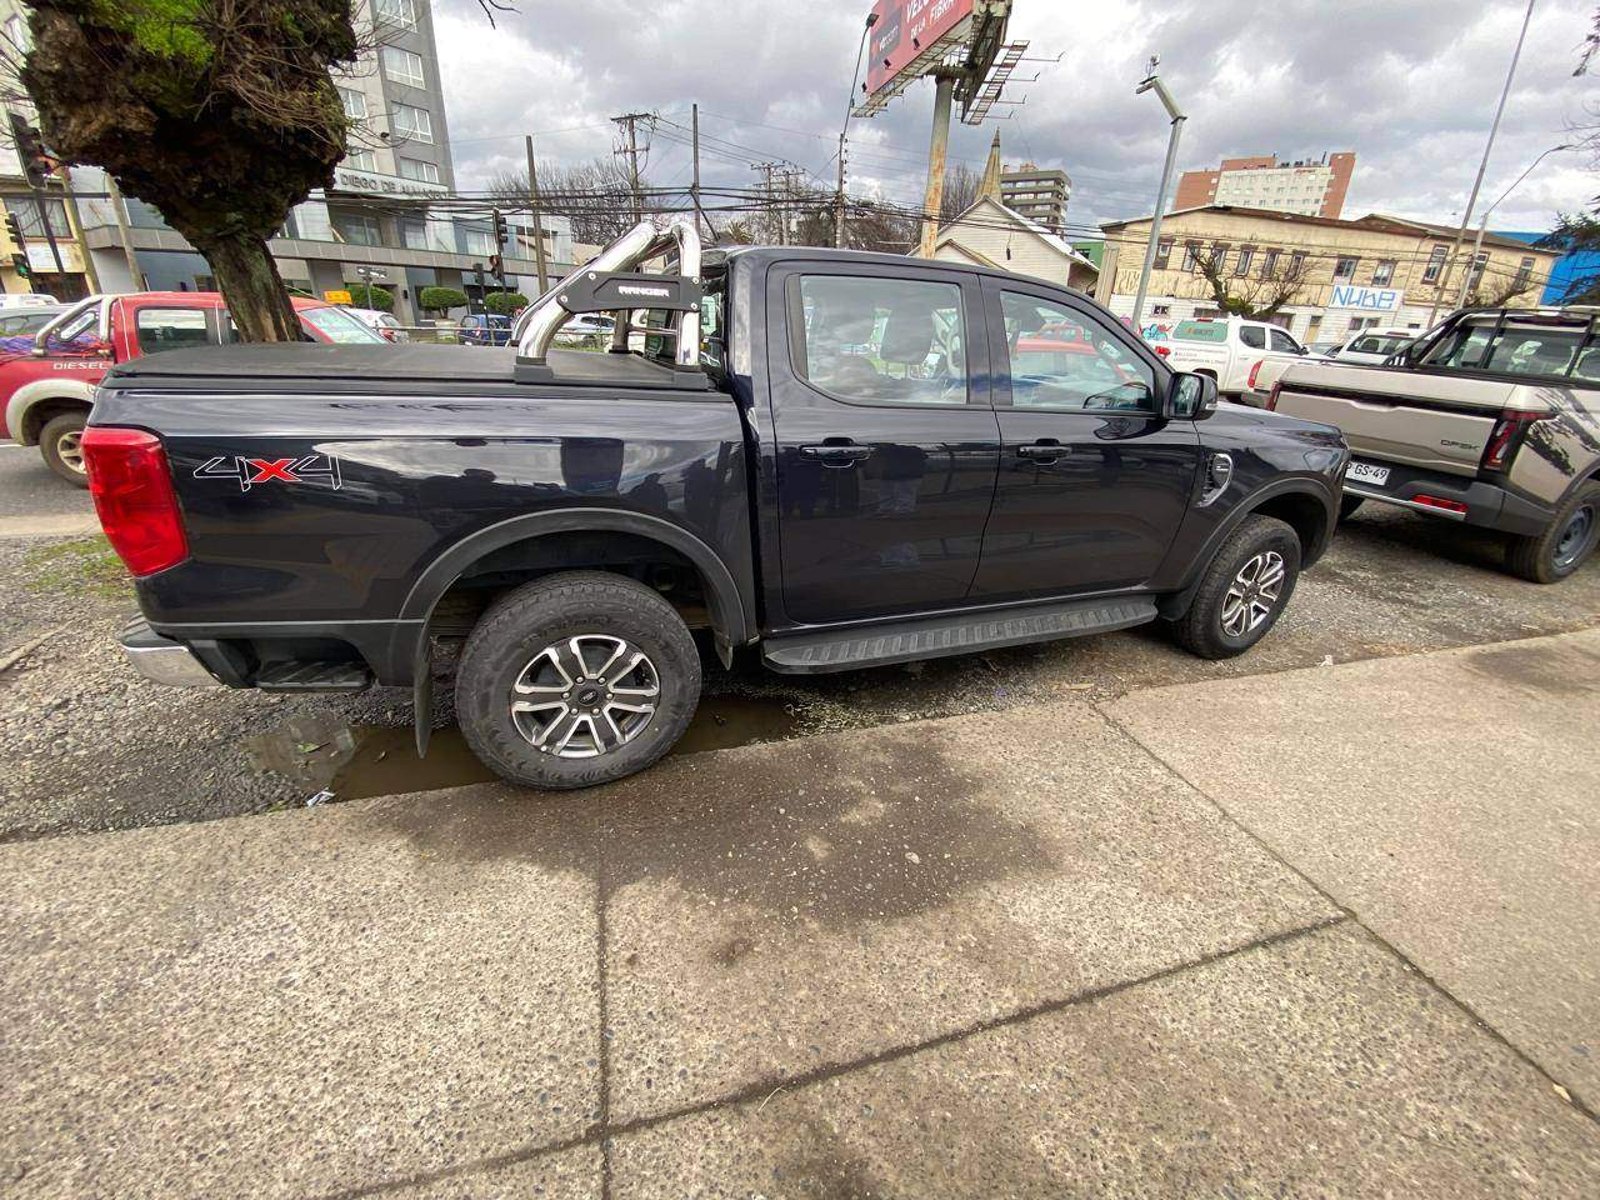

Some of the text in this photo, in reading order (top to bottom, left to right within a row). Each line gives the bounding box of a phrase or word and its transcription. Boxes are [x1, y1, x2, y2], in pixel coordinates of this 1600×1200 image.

[340, 173, 377, 190] DIEGO
[381, 182, 396, 193] DE
[618, 286, 669, 297] RANGER
[53, 362, 108, 370] DIESEL
